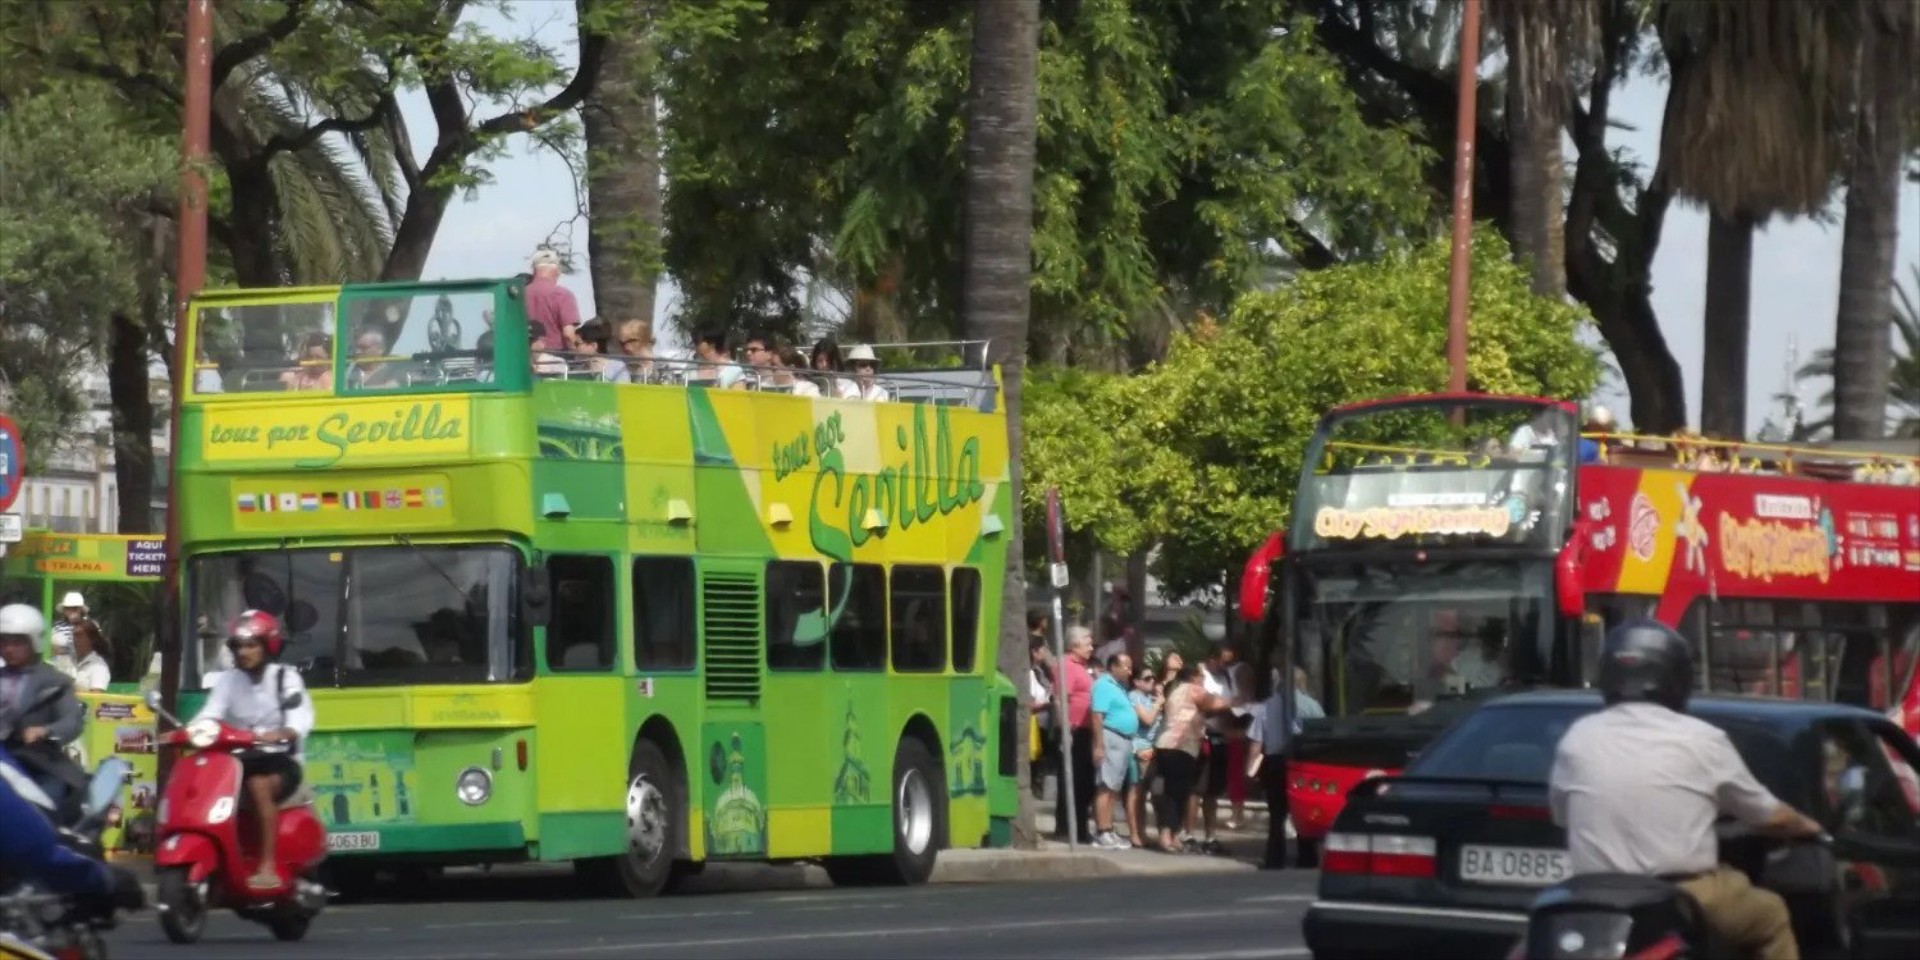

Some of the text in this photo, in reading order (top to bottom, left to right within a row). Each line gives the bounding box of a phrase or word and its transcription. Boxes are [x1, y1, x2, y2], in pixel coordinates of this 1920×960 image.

[210, 402, 462, 468] tour por Sevilla
[772, 409, 845, 482] tour por
[793, 400, 984, 646] Sevilla
